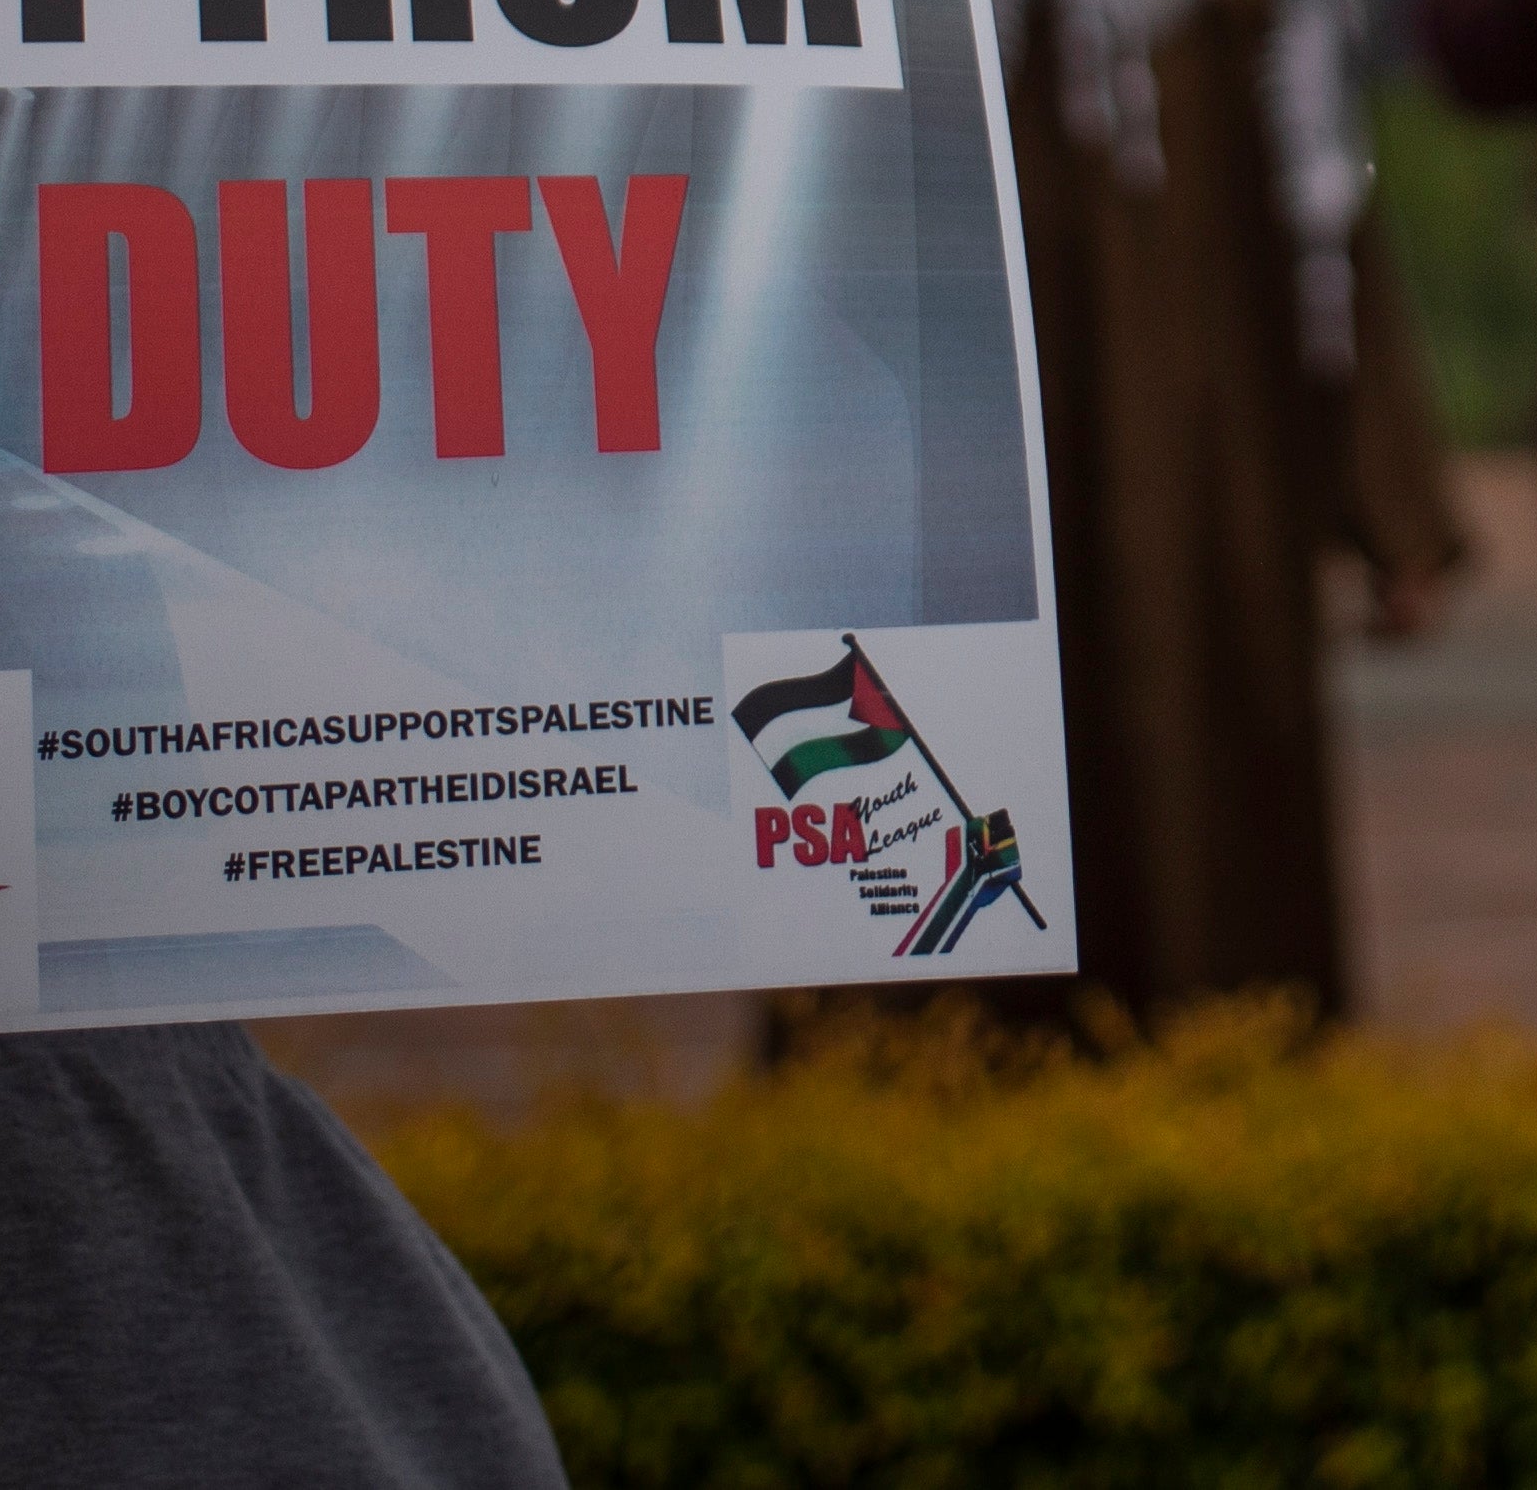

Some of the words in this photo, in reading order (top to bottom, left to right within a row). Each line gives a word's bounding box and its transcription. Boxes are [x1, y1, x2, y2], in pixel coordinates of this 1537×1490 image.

[38, 175, 688, 474] DUTY
[37, 697, 714, 761] #SOUTHAFRICASUPPORTSPALESTINE
[111, 765, 637, 822] #BOYCOTTAPARTHEIDISRAEL
[849, 772, 918, 824] Youth
[754, 803, 868, 869] PSA
[864, 807, 943, 856] League
[224, 835, 541, 882] #FREEPALESTINE
[850, 868, 907, 881] Palestine
[859, 885, 918, 899] Solidarity
[870, 903, 920, 917] Alliance
